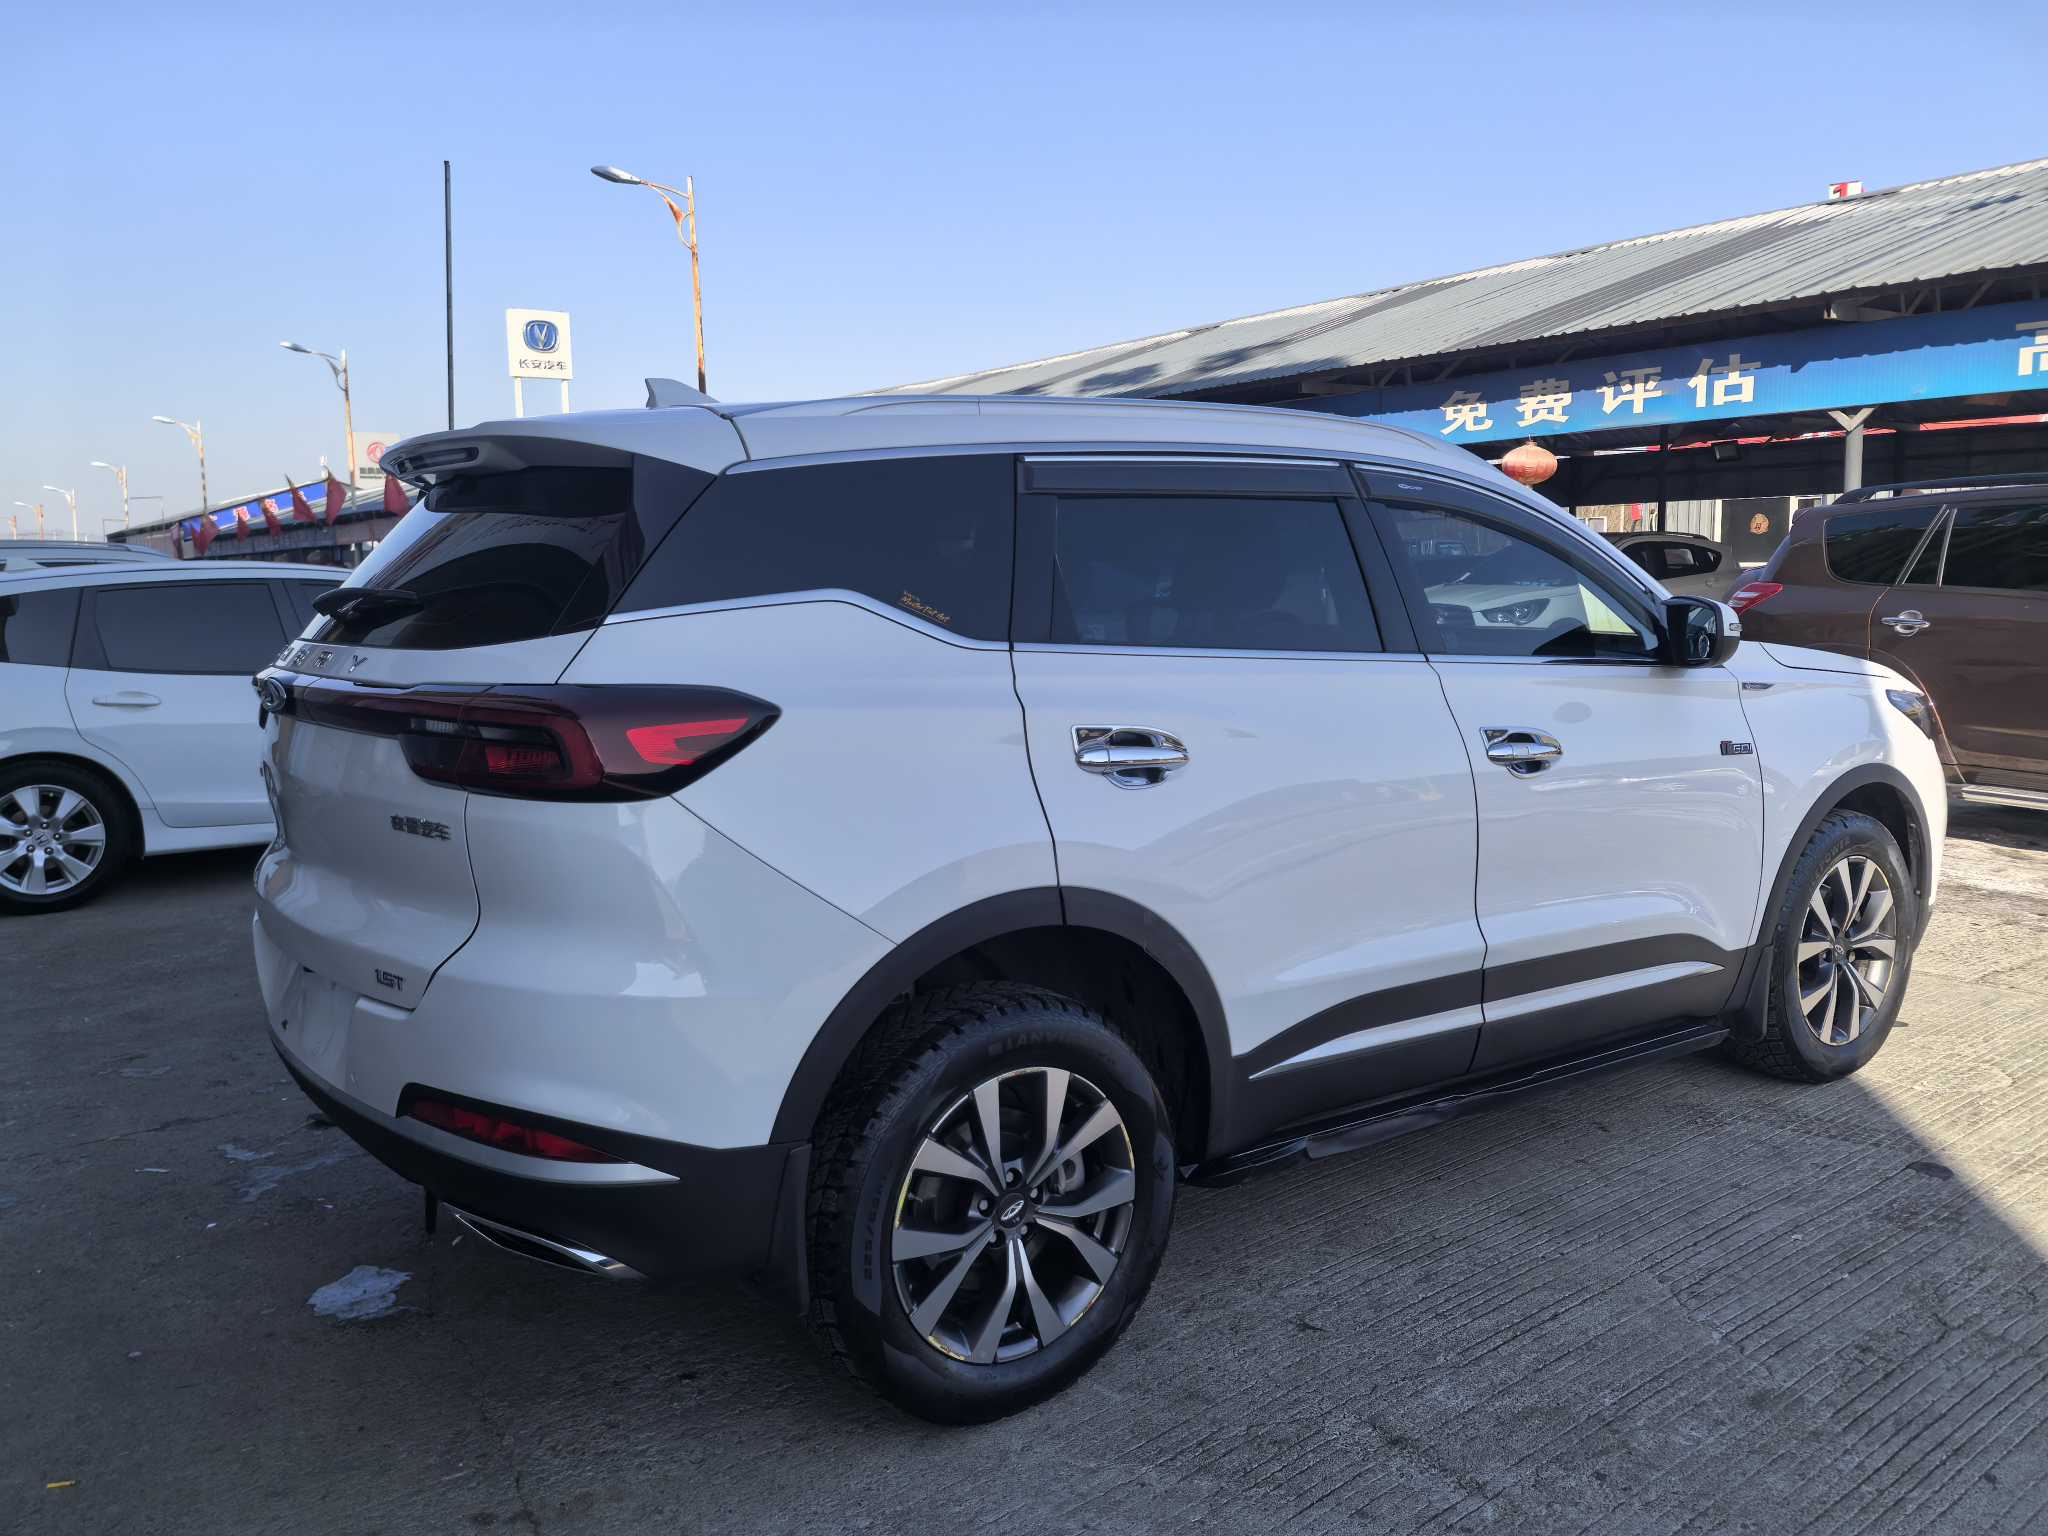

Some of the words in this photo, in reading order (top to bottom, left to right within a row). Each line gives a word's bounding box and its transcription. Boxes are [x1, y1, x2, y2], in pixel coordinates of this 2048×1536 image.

[518, 358, 568, 371] 长安汽车
[1440, 353, 1762, 435] 免费评估
